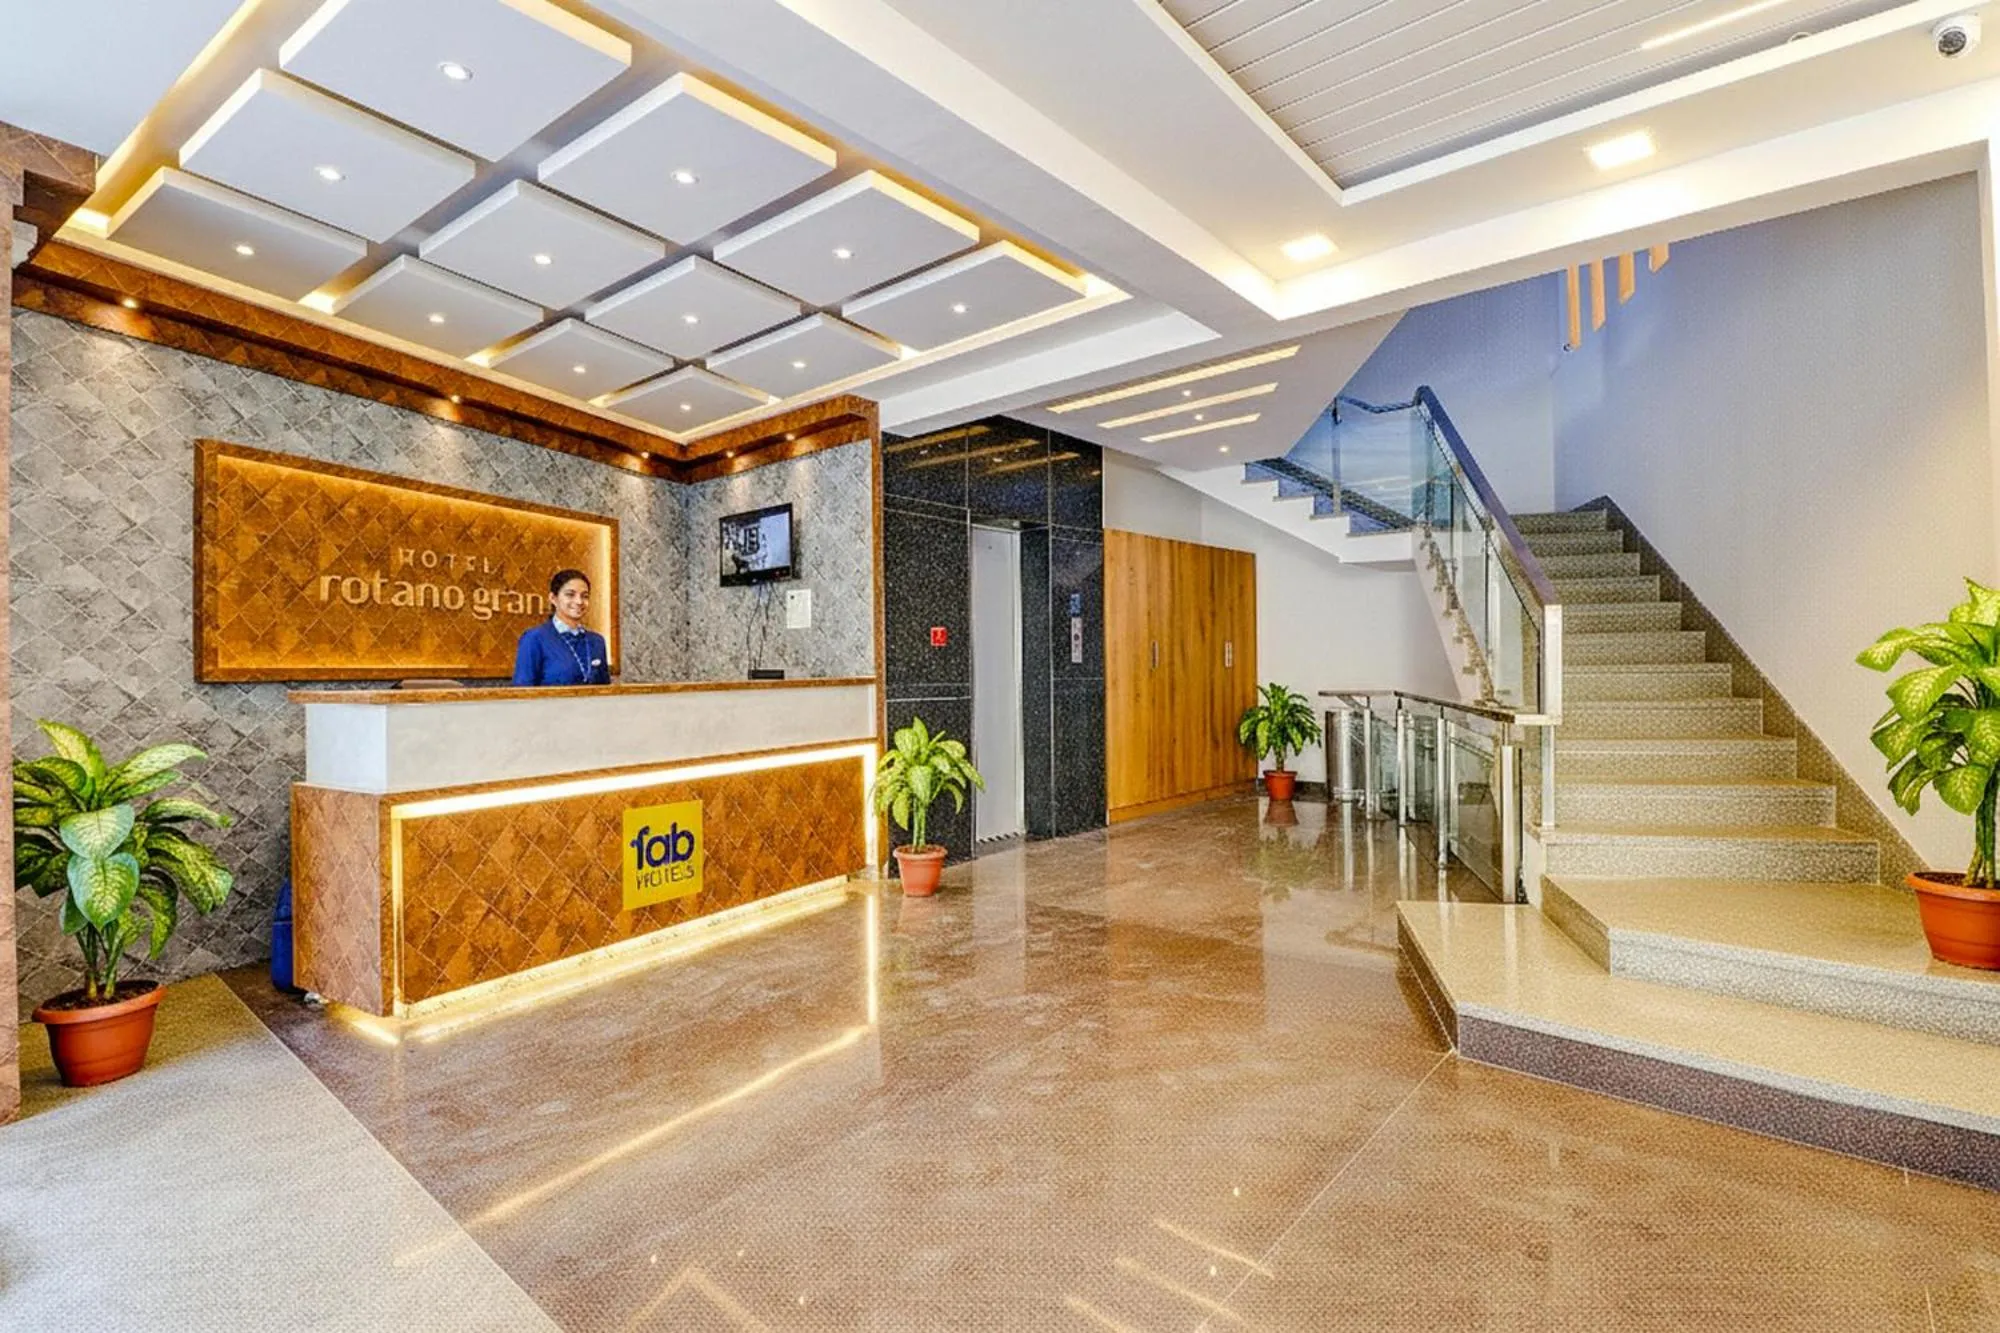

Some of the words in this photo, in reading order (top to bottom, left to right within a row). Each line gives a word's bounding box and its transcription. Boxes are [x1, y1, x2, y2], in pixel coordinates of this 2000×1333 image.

[398, 548, 497, 573] HOTEL
[319, 569, 465, 610] rotano
[471, 585, 551, 620] gran
[630, 822, 694, 870] fab
